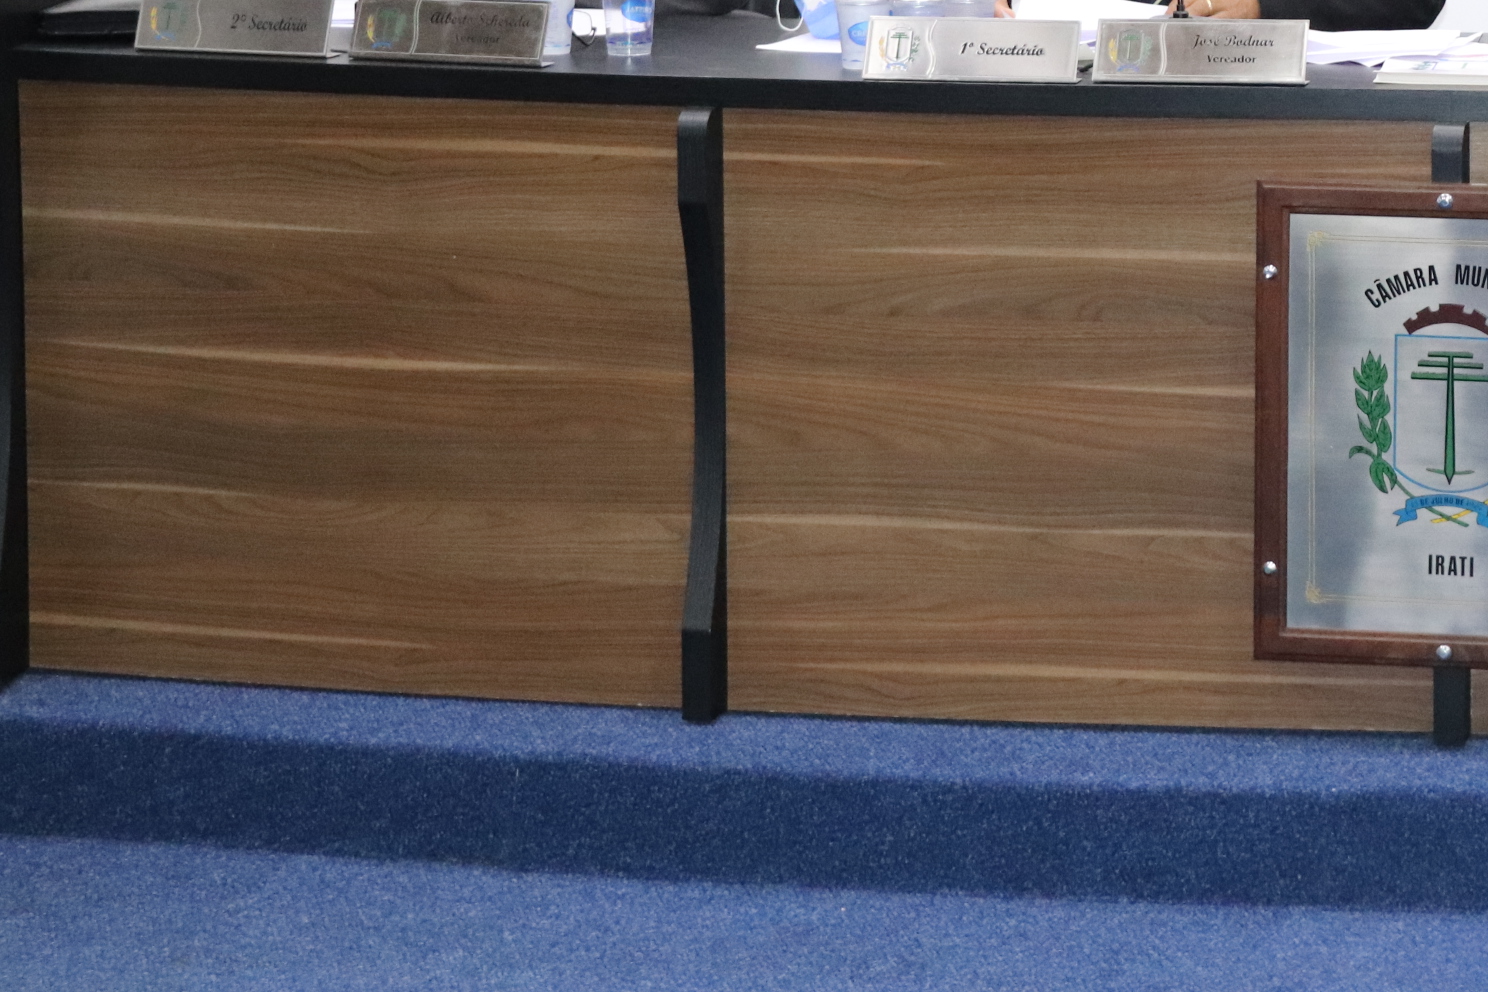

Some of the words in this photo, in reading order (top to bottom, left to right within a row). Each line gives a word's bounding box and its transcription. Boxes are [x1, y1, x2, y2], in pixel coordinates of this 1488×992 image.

[247, 14, 308, 32] Secretário
[976, 42, 1045, 56] Secretário
[1192, 34, 1221, 49] José
[1223, 34, 1275, 47] Bodnar
[1207, 54, 1257, 64] Vereador
[1364, 264, 1439, 309] CÂMARA
[1428, 554, 1474, 577] IRATI
